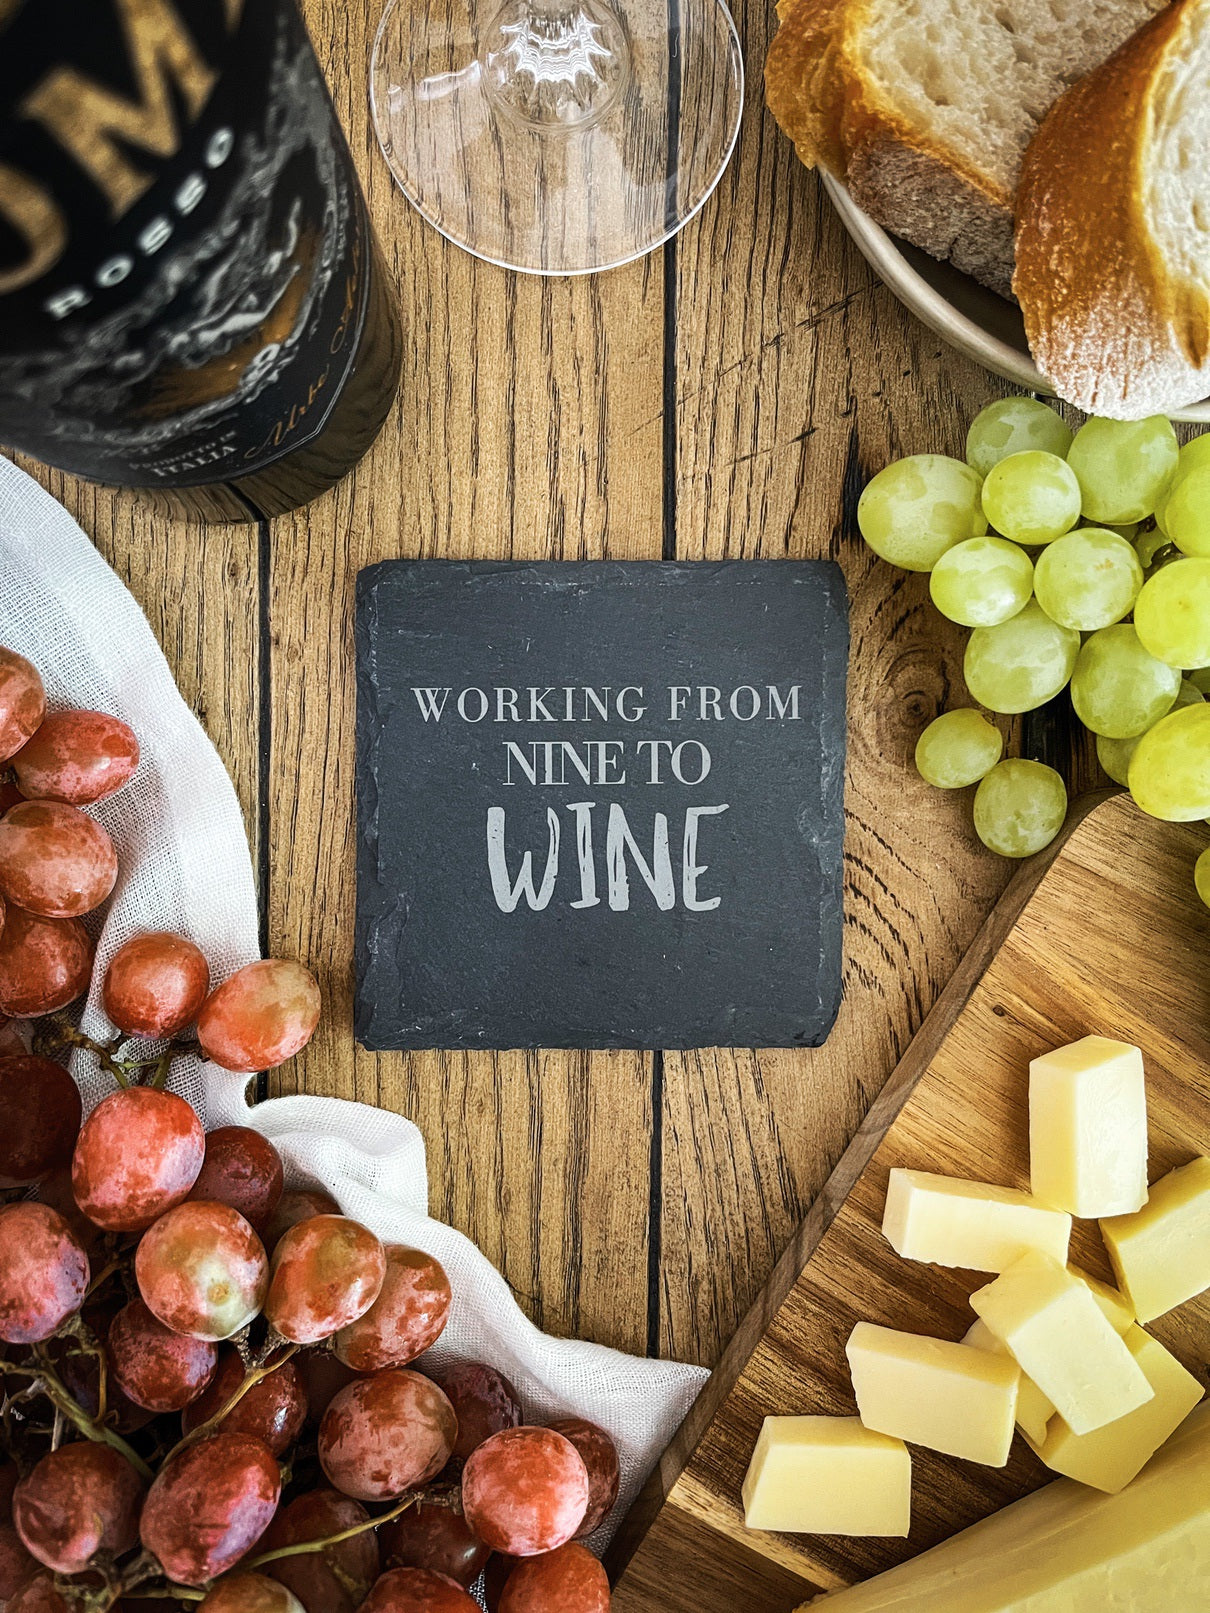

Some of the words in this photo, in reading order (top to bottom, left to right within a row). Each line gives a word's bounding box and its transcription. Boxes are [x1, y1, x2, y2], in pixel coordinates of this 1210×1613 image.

[46, 128, 234, 319] ROSSO
[151, 446, 237, 477] ITALIA
[411, 687, 647, 722] WORKING
[668, 686, 802, 720] FROM
[502, 741, 625, 785] NINE
[637, 740, 711, 785] TO
[487, 802, 729, 912] WINE
